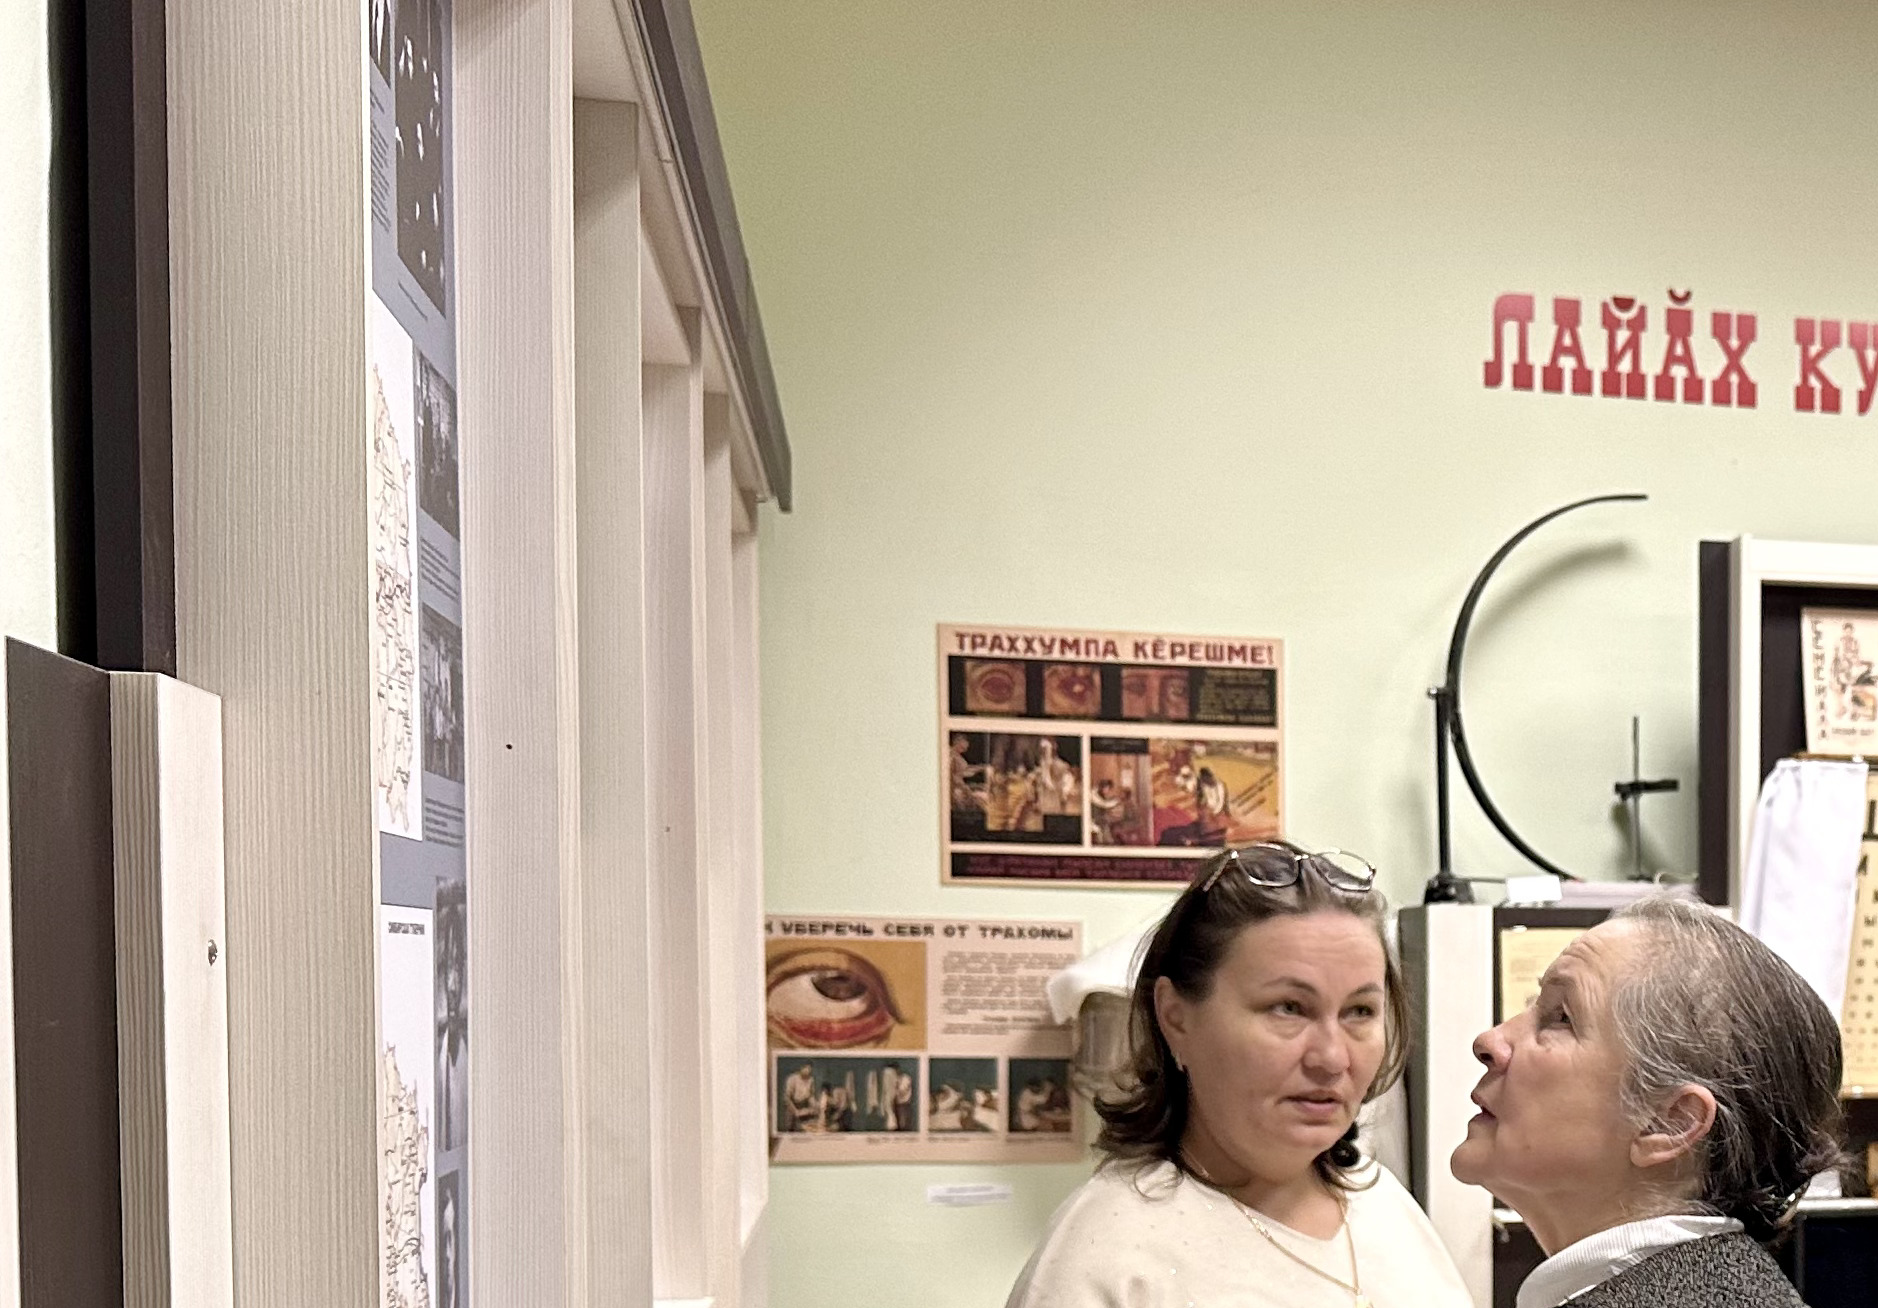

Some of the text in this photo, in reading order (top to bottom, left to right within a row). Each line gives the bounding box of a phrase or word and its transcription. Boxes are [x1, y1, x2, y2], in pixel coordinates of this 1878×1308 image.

[955, 631, 1120, 659] ТРАХХУМПА
[781, 920, 874, 937] УБЕРЕЧЬ
[883, 923, 935, 938] СЕБЯ
[943, 924, 969, 939] ОТ
[979, 926, 1074, 941] ТРАХОМЫ
